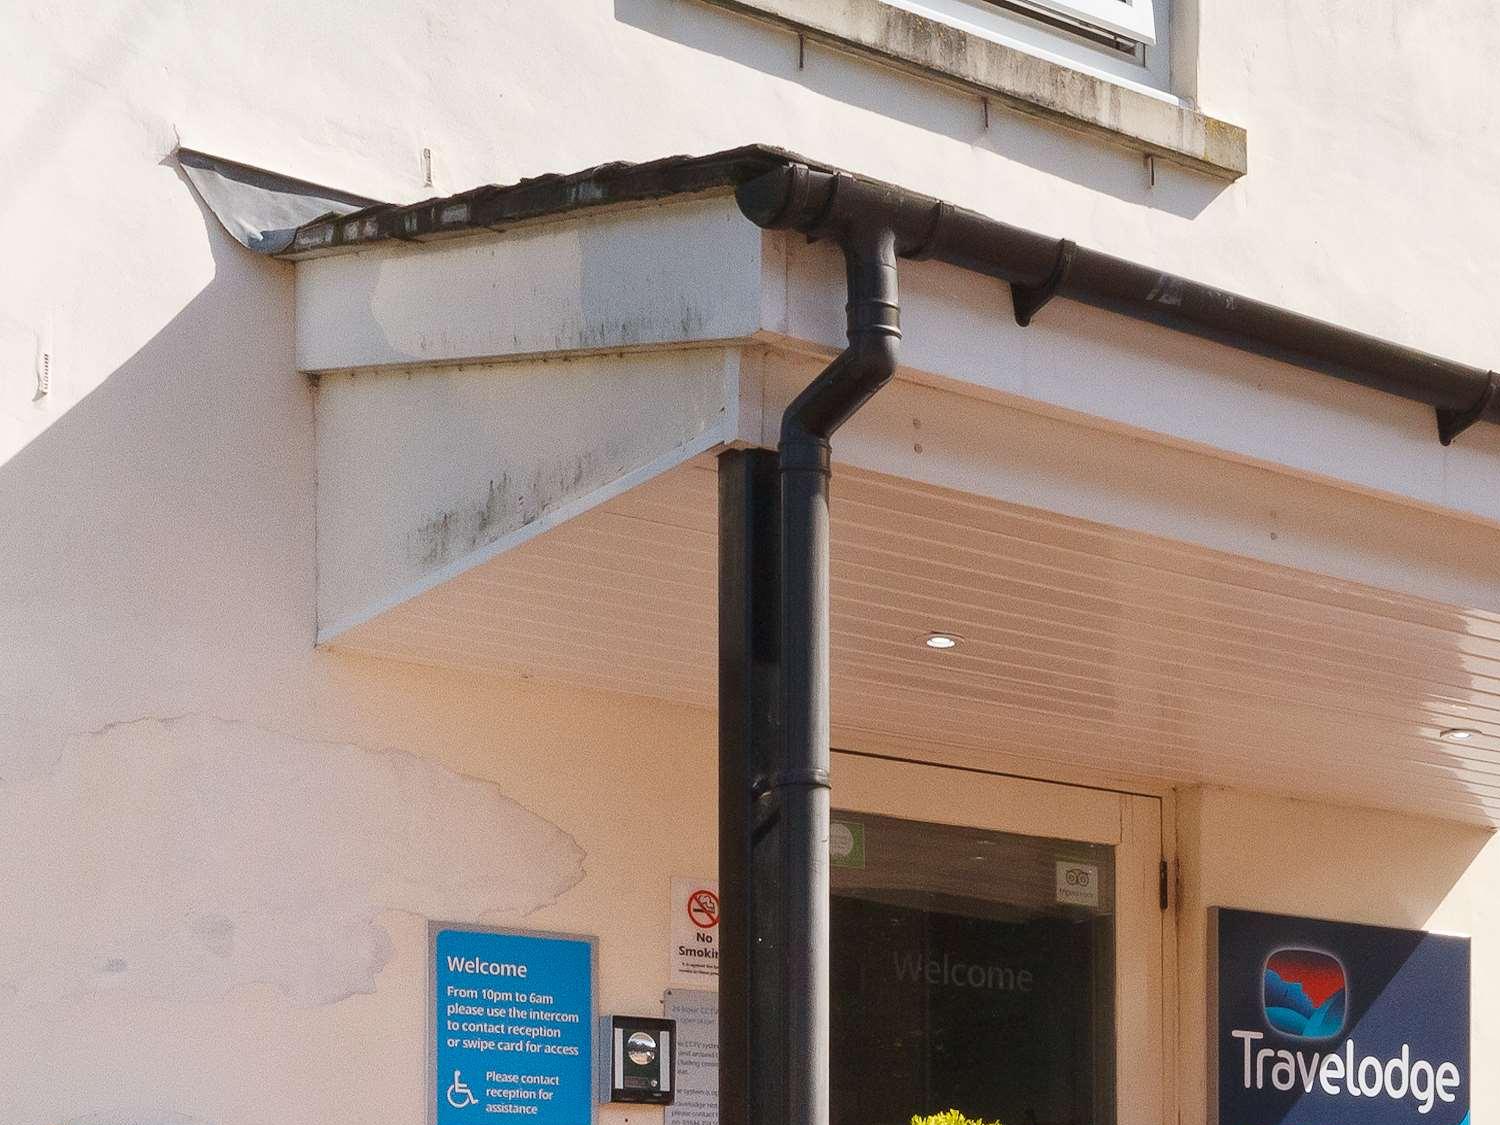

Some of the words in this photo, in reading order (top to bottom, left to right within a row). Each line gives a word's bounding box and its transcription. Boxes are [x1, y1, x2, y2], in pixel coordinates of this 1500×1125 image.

[696, 932, 713, 944] No
[447, 956, 528, 978] Welcome
[894, 950, 1033, 992] Welcome
[447, 986, 478, 999] From
[482, 989, 513, 1003] 10pm
[515, 991, 527, 1003] to
[529, 993, 554, 1005] 6am
[447, 1002, 484, 1016] please
[486, 1006, 507, 1018] use
[509, 1006, 527, 1019] the
[529, 1009, 579, 1024] intercom
[447, 1020, 460, 1032] to
[462, 1021, 505, 1035] contact
[507, 1025, 561, 1039] reception
[447, 1037, 460, 1048] or
[462, 1038, 496, 1052] swipe
[497, 1040, 523, 1053] card
[525, 1041, 541, 1053] for
[544, 1043, 579, 1056] access
[486, 1071, 519, 1084] Please
[521, 1074, 560, 1086] contact
[1231, 1029, 1461, 1115] Travelodge
[486, 1086, 537, 1101] reception
[538, 1088, 554, 1101] for
[485, 1102, 538, 1115] assistance
